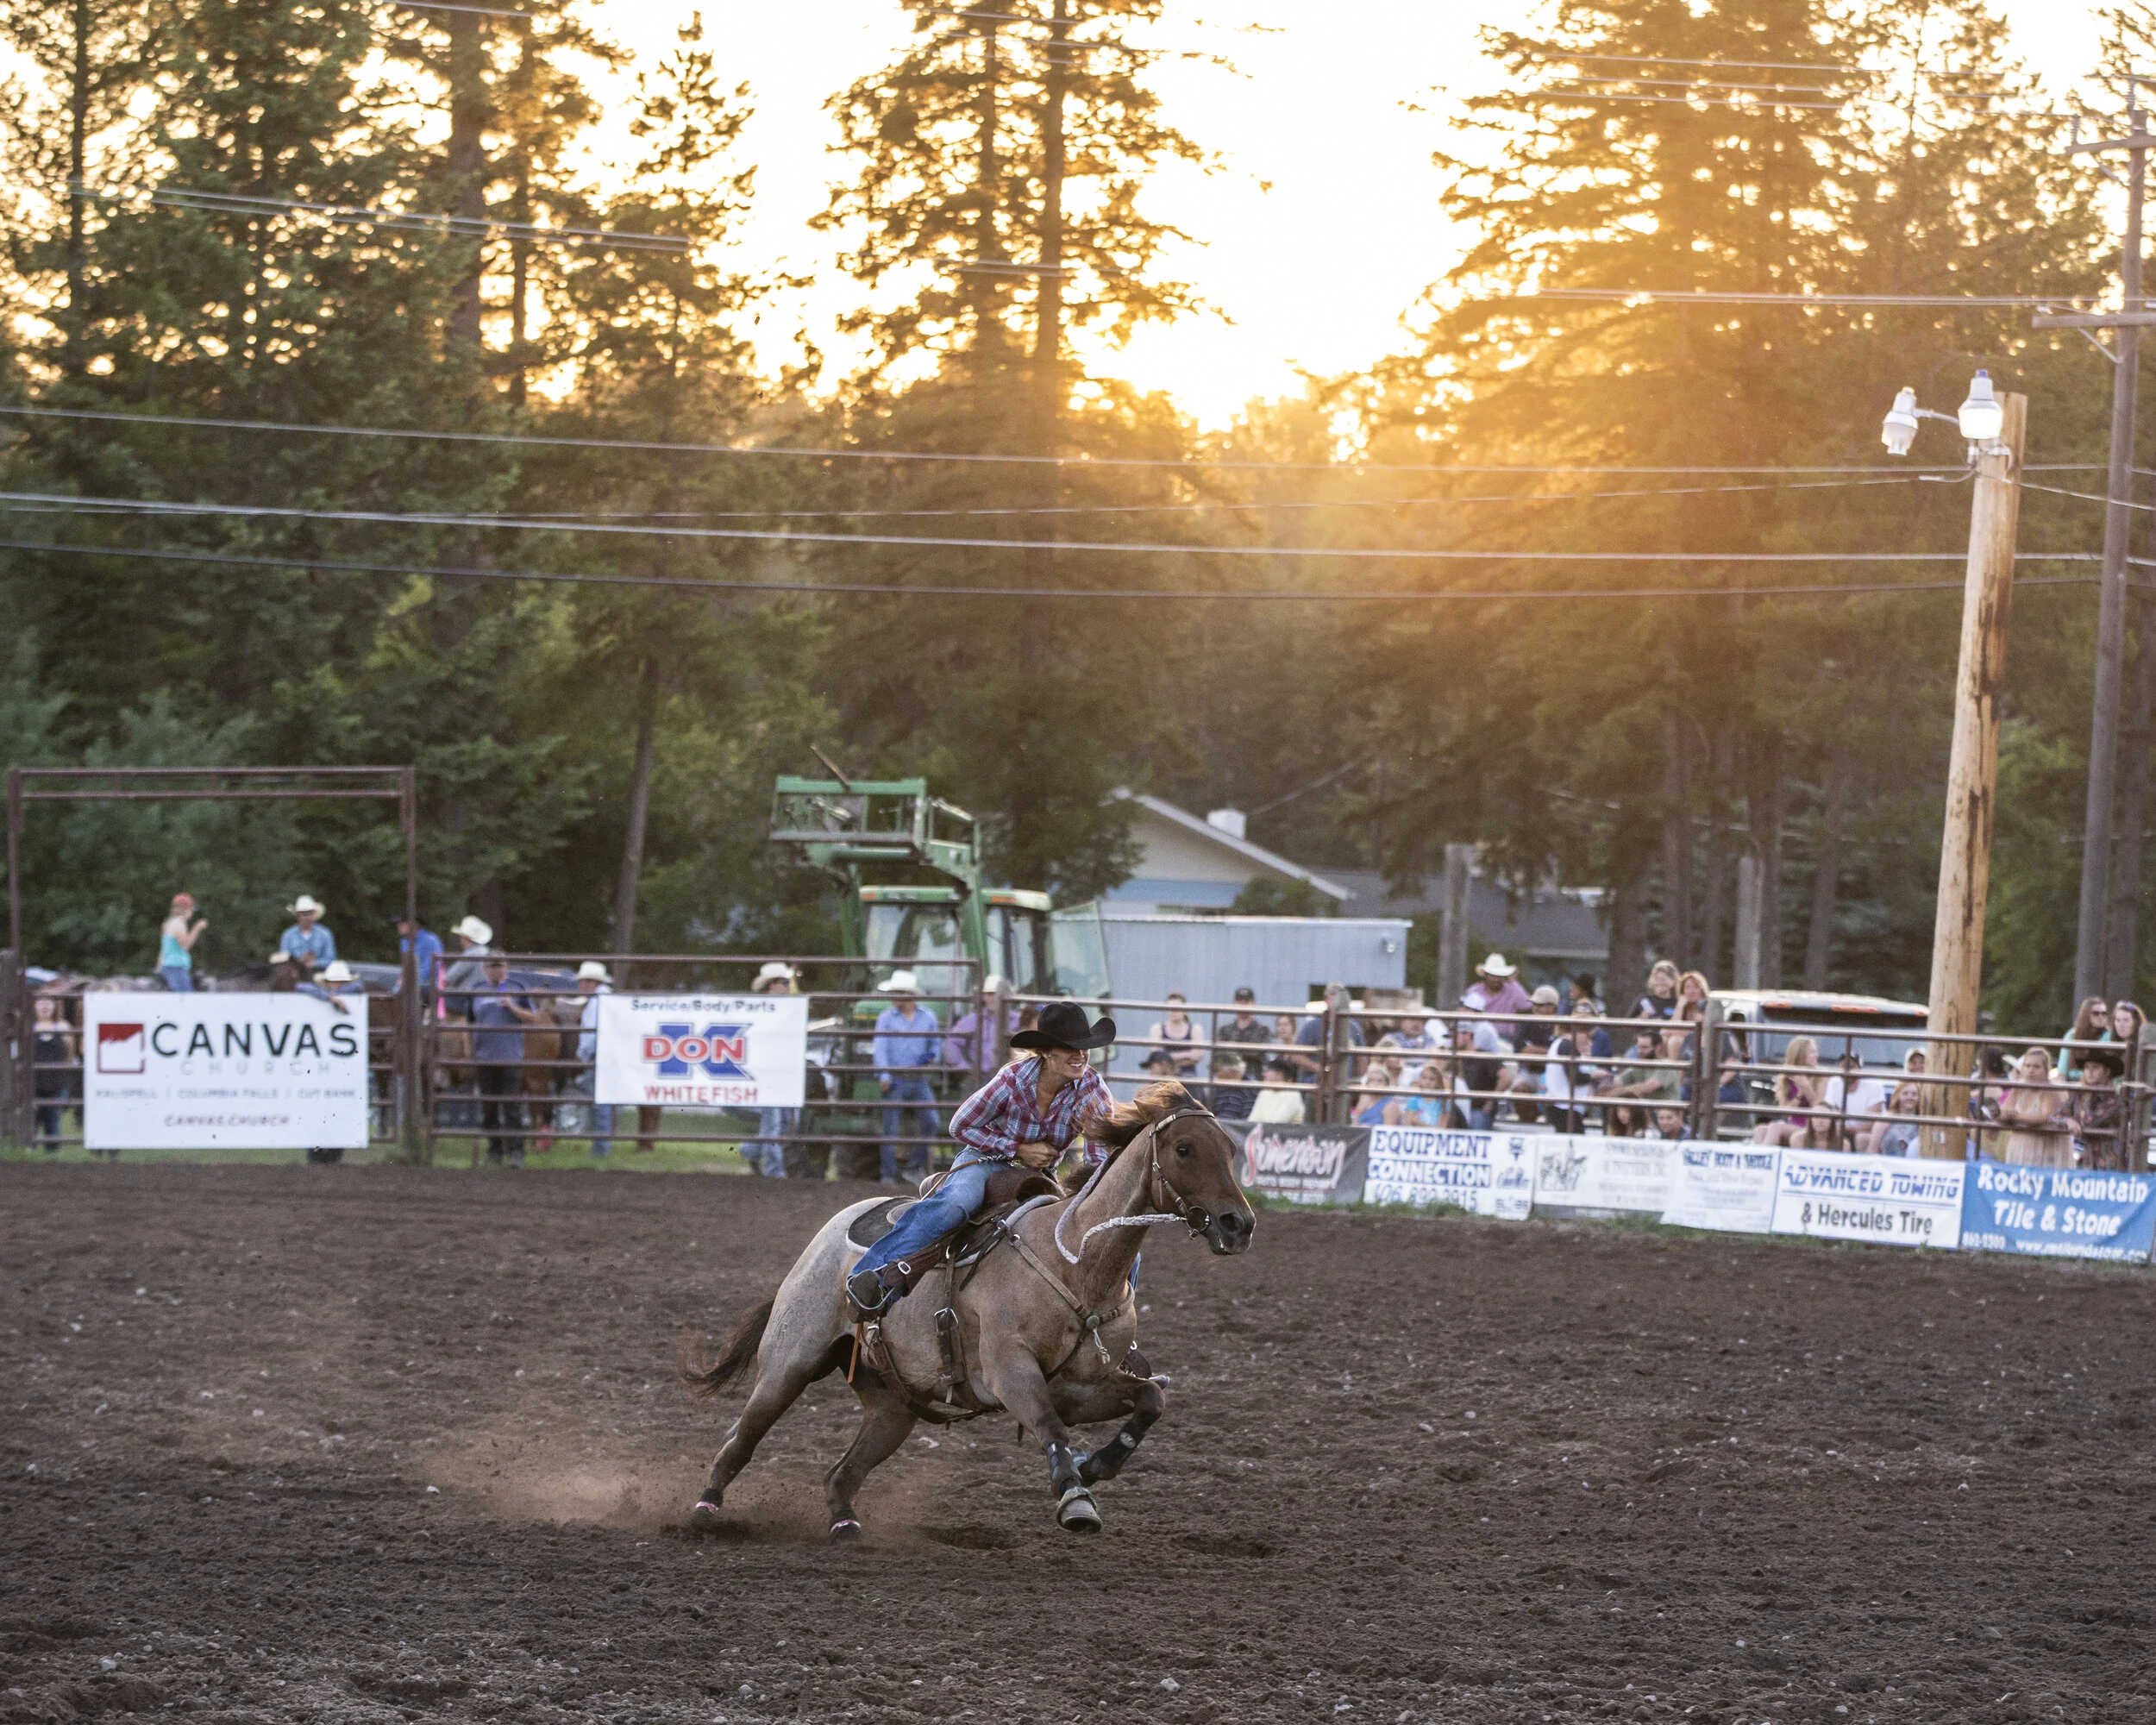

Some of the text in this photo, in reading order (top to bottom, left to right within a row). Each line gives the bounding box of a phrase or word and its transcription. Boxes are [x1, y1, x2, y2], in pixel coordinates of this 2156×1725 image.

[151, 1023, 359, 1057] CANVAS
[642, 1036, 745, 1062] DON
[179, 1062, 330, 1076] CHURCH
[643, 1086, 759, 1103] WHITEFISH
[1372, 1130, 1493, 1159] EQUIPMENT
[1368, 1160, 1492, 1187] CONNECTION
[1784, 1165, 1884, 1192] ADVANCED
[1890, 1173, 1960, 1199] TOWING
[1977, 1164, 2149, 1204] Rocky Mountain
[1801, 1202, 1933, 1235] & Hercules Tire
[1993, 1201, 2122, 1237] Tile & Stone
